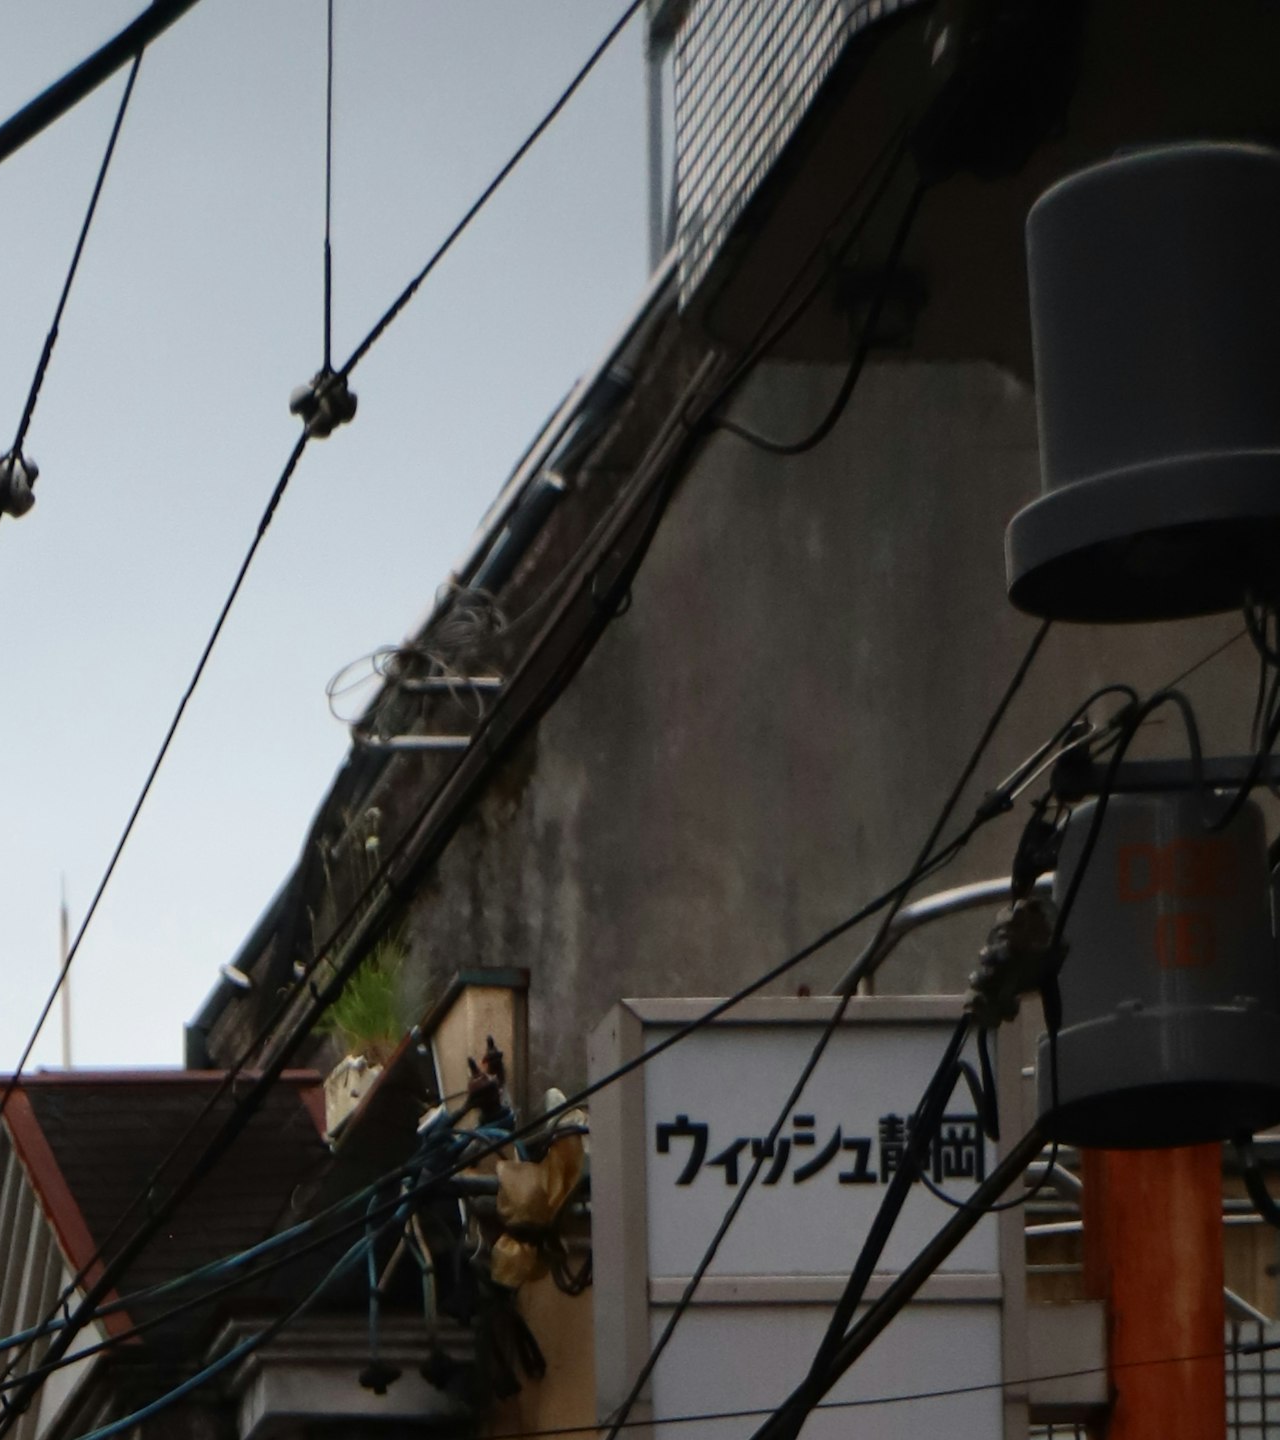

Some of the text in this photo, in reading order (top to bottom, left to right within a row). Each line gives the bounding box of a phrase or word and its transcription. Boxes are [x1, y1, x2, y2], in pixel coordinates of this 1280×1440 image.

[656, 1114, 984, 1184] ウィッシュ静岡
